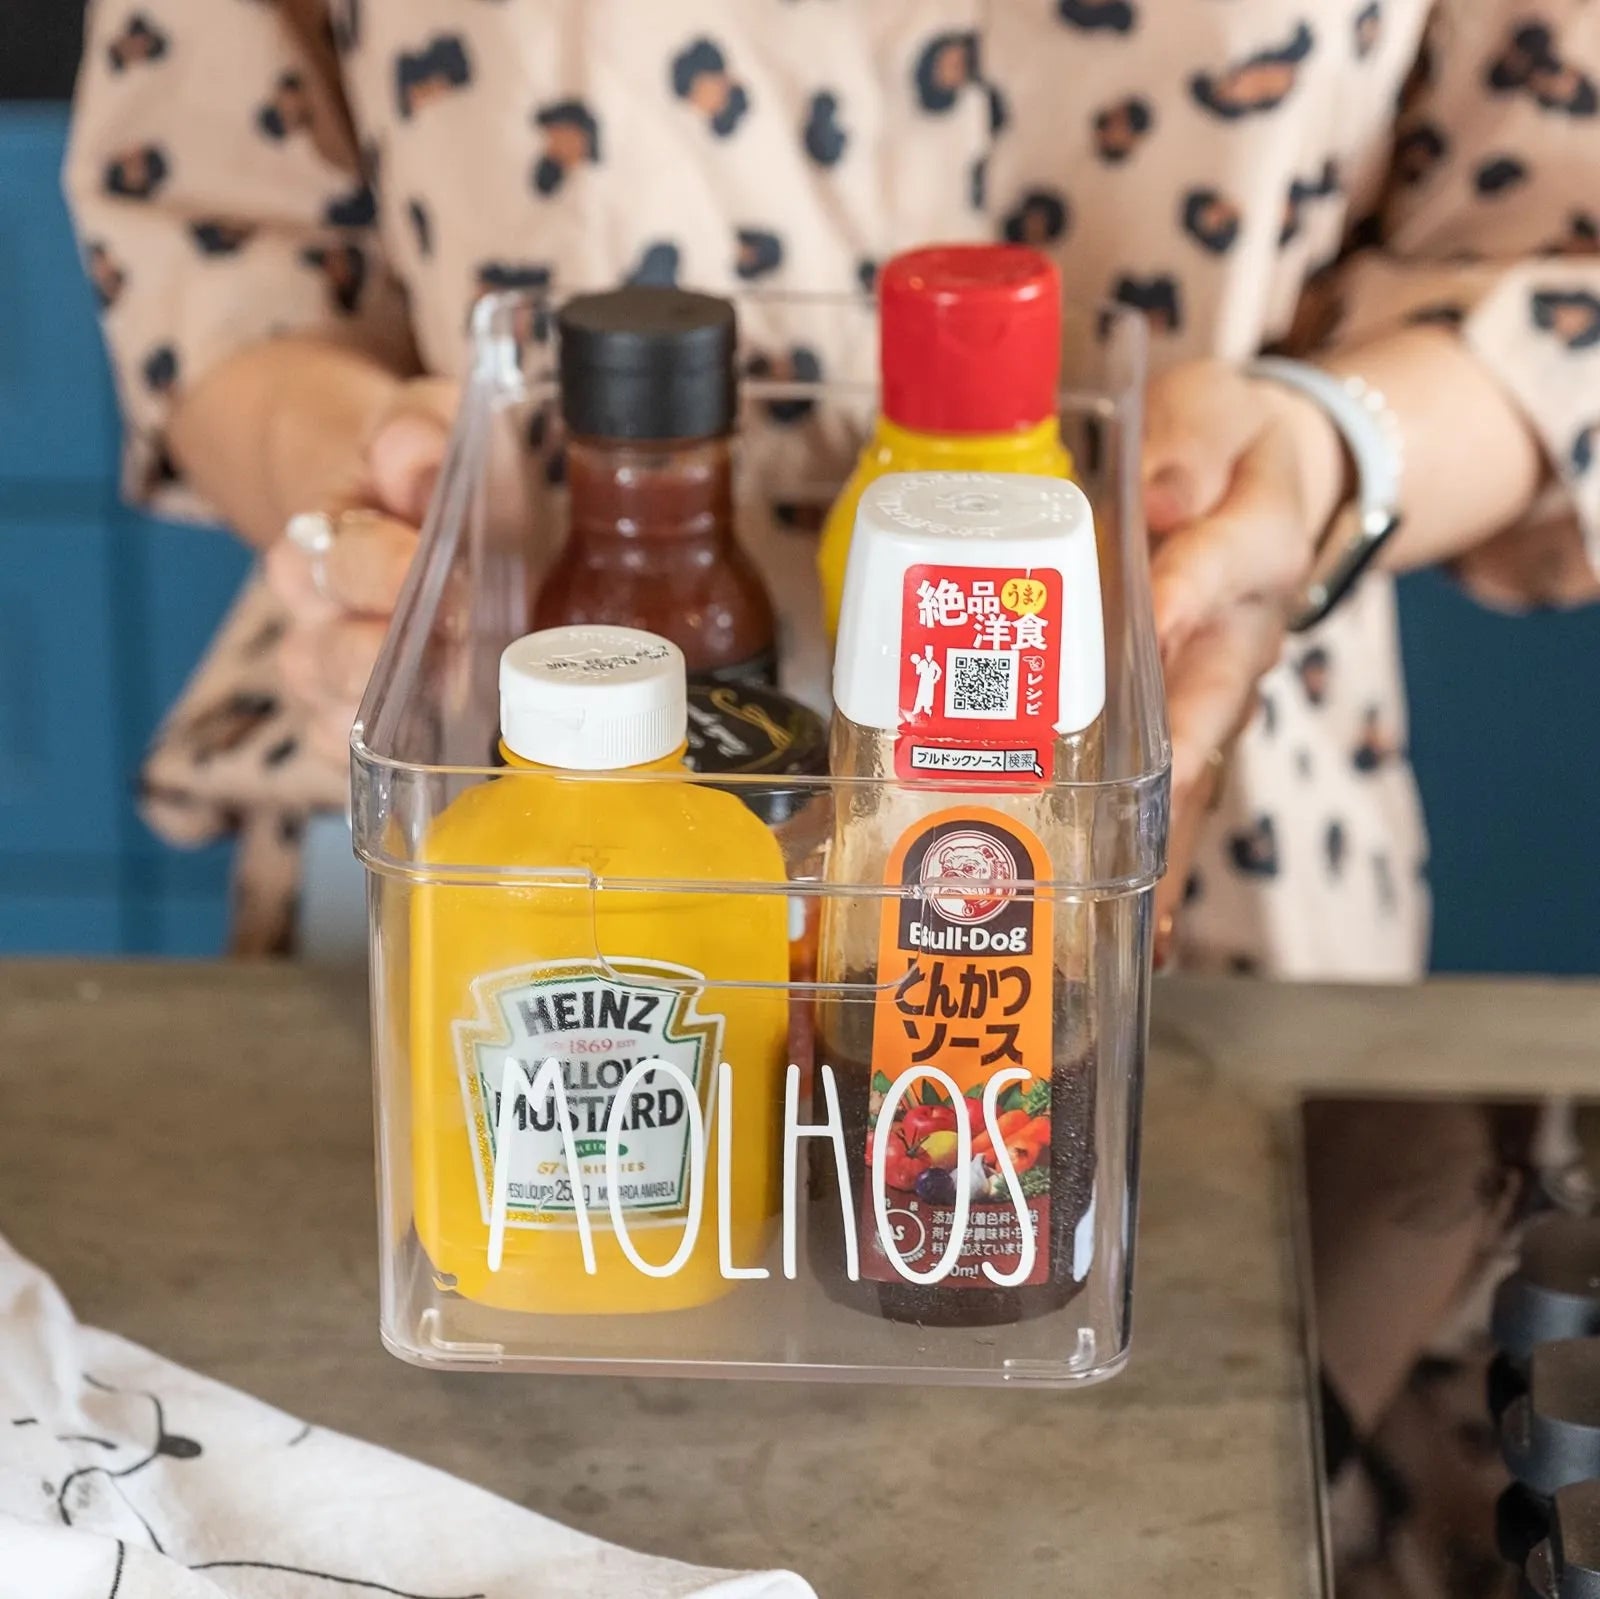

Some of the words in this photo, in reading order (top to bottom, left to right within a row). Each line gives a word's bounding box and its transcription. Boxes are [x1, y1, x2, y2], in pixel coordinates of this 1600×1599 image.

[916, 578, 1000, 628] 絶品
[972, 612, 1049, 650] 洋食
[917, 751, 1002, 768] ブルドックソース
[1007, 753, 1033, 768] 検索
[909, 922, 1027, 952] Bull-Dog
[895, 957, 1032, 1019] とんかつ
[515, 989, 661, 1037] HEINZ
[569, 1038, 613, 1054] 1869
[903, 1020, 1023, 1066] ソース
[519, 1054, 660, 1090] YLLOW
[486, 1056, 1033, 1286] MOLHOS
